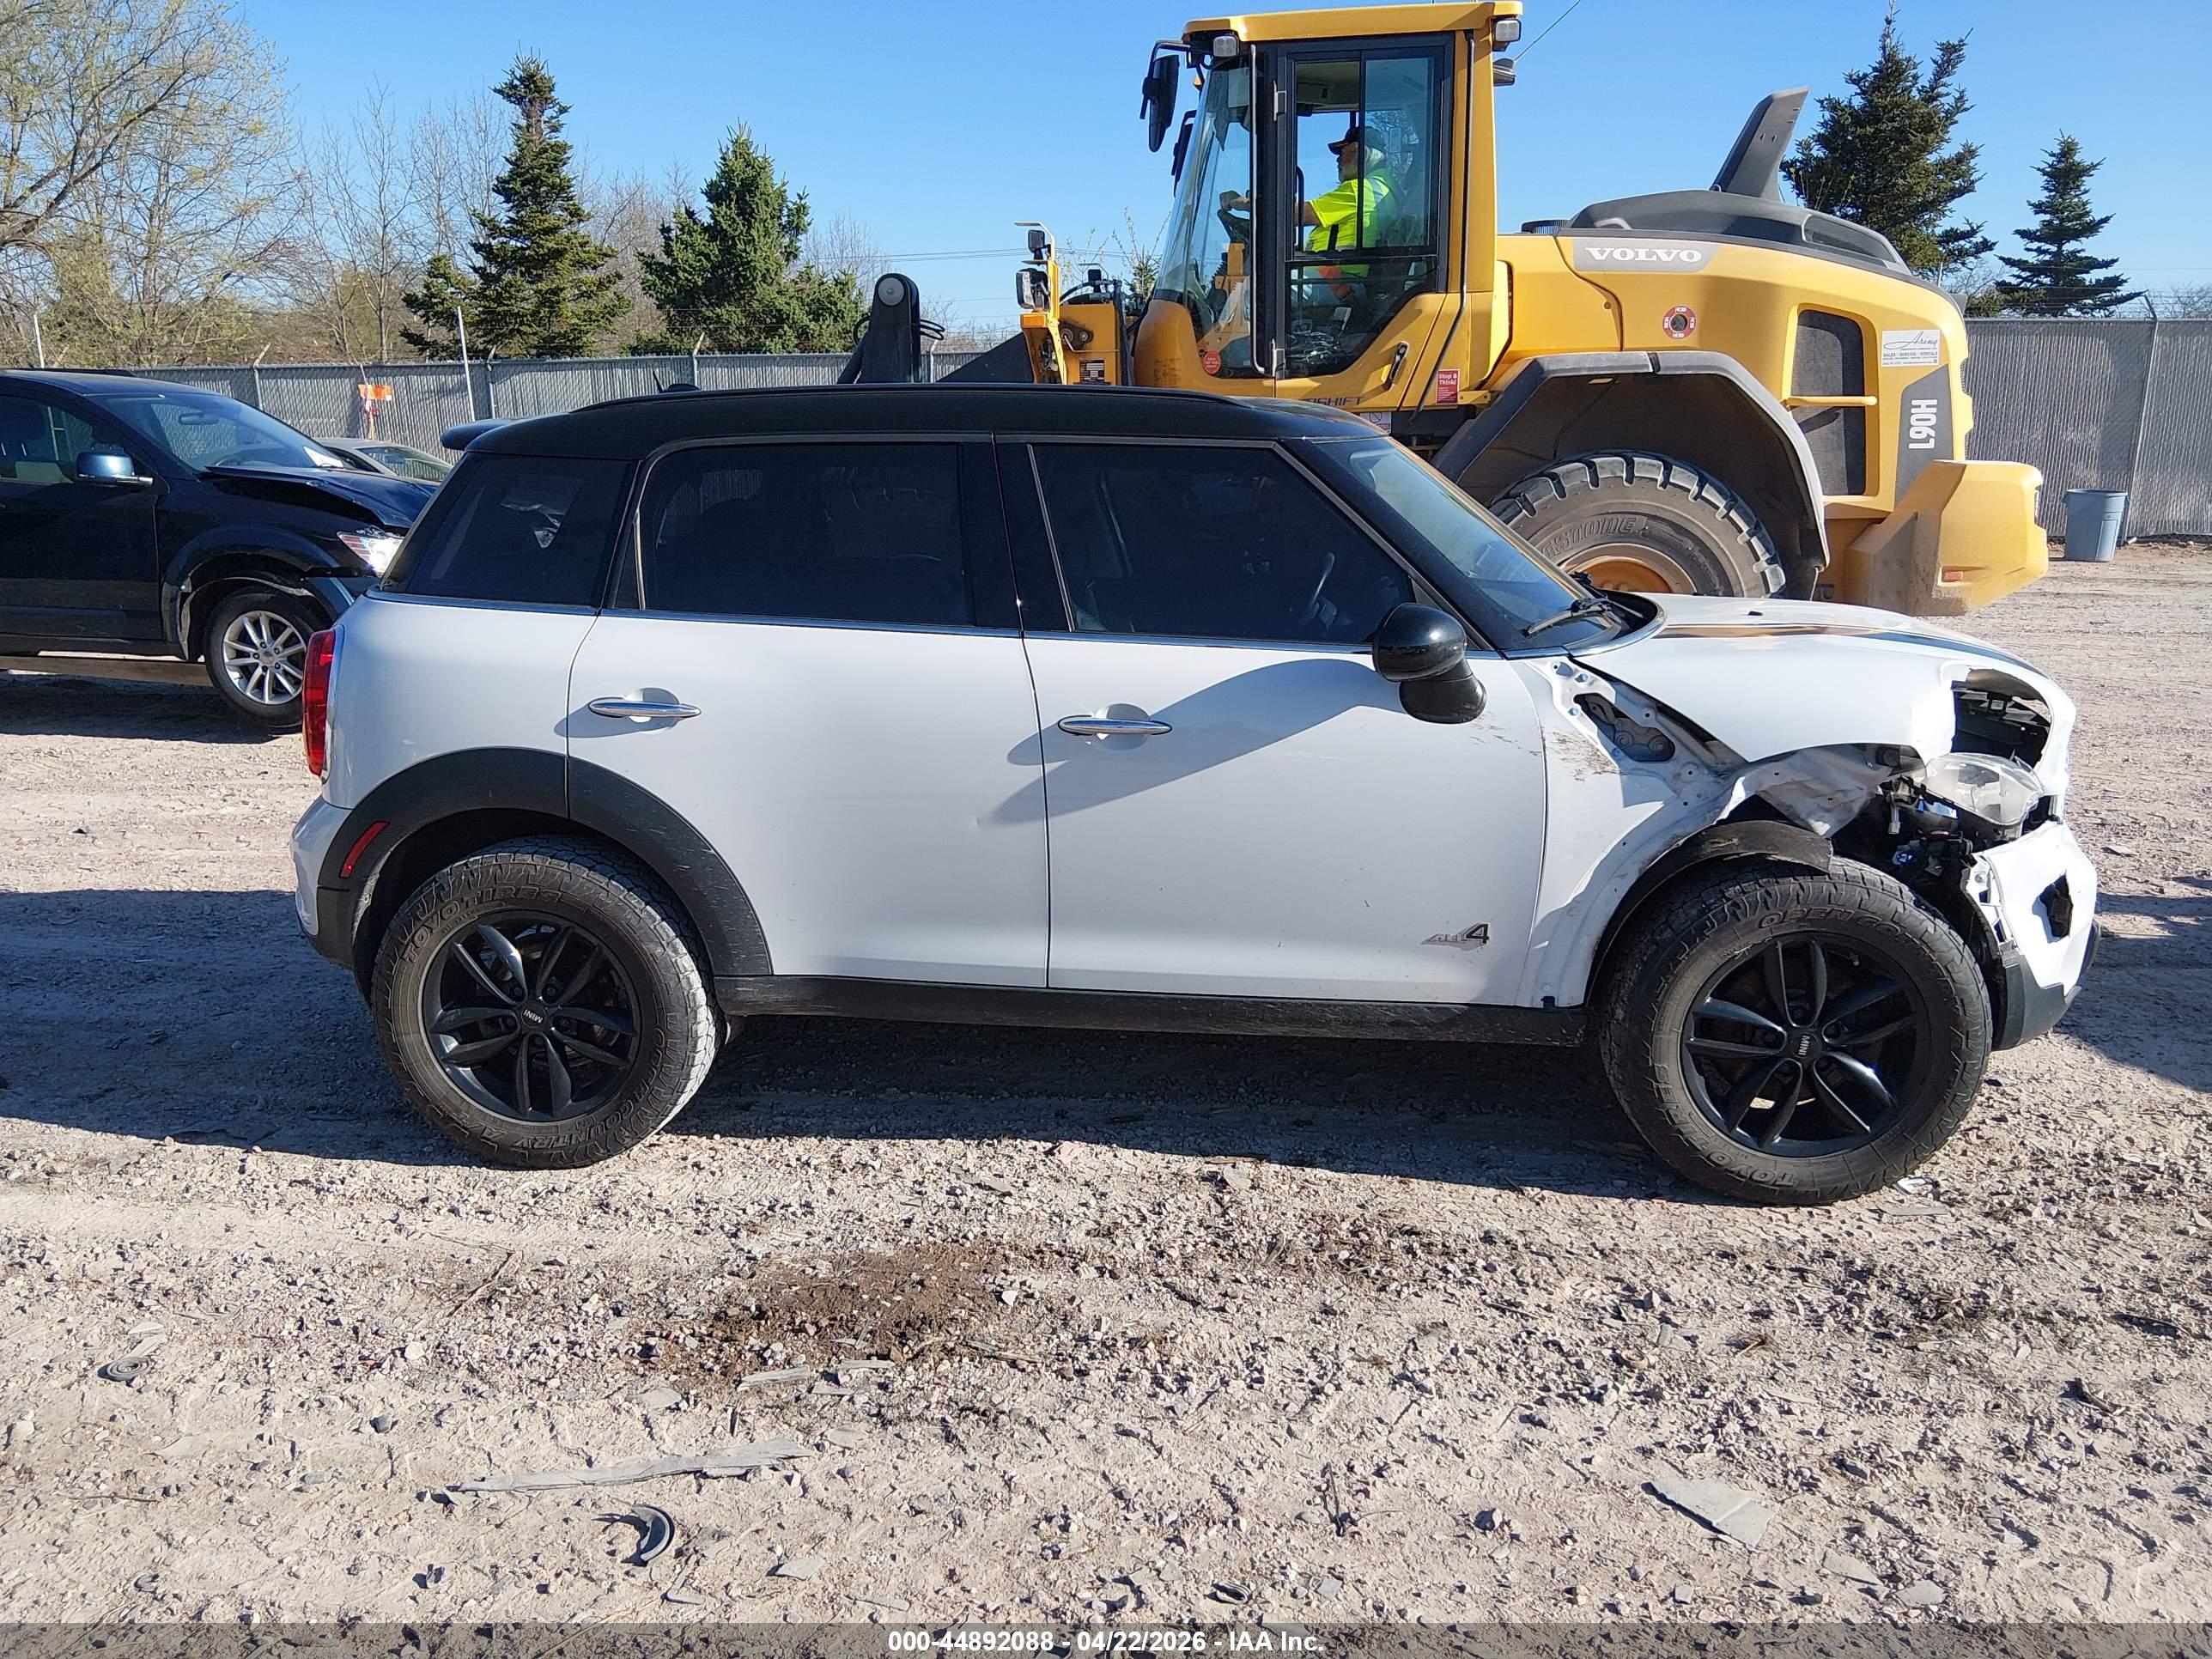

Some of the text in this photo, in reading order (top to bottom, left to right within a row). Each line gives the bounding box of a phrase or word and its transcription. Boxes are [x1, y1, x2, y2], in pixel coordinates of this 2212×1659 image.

[1585, 247, 1702, 263] VOLVO
[1908, 398, 1938, 450] L90H
[1759, 906, 1855, 928] OPEN
[402, 899, 461, 963] TOYO
[523, 1009, 544, 1024] MINI
[1797, 1035, 1811, 1056] MINI
[1707, 1149, 1797, 1187] TOYO
